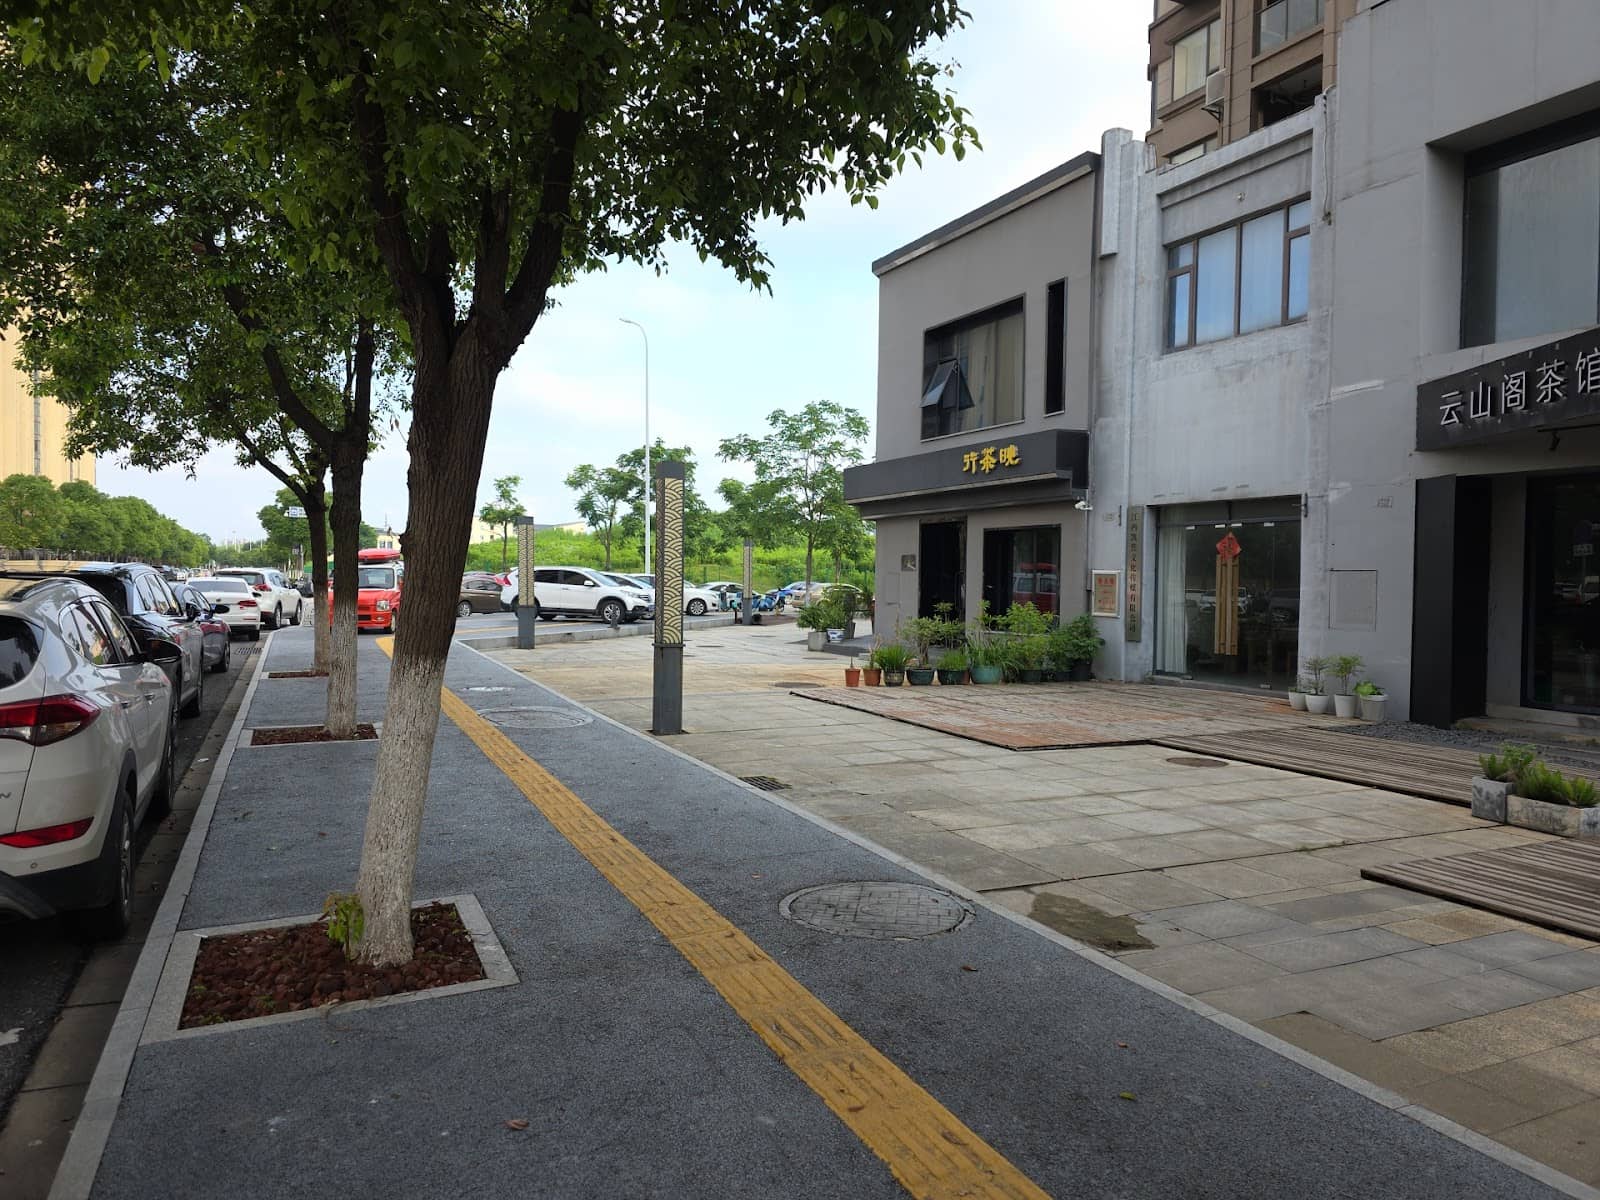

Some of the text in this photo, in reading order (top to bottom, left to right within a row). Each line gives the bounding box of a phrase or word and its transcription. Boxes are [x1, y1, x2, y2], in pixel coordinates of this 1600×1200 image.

[1439, 347, 1600, 425] 云山阁茶馆
